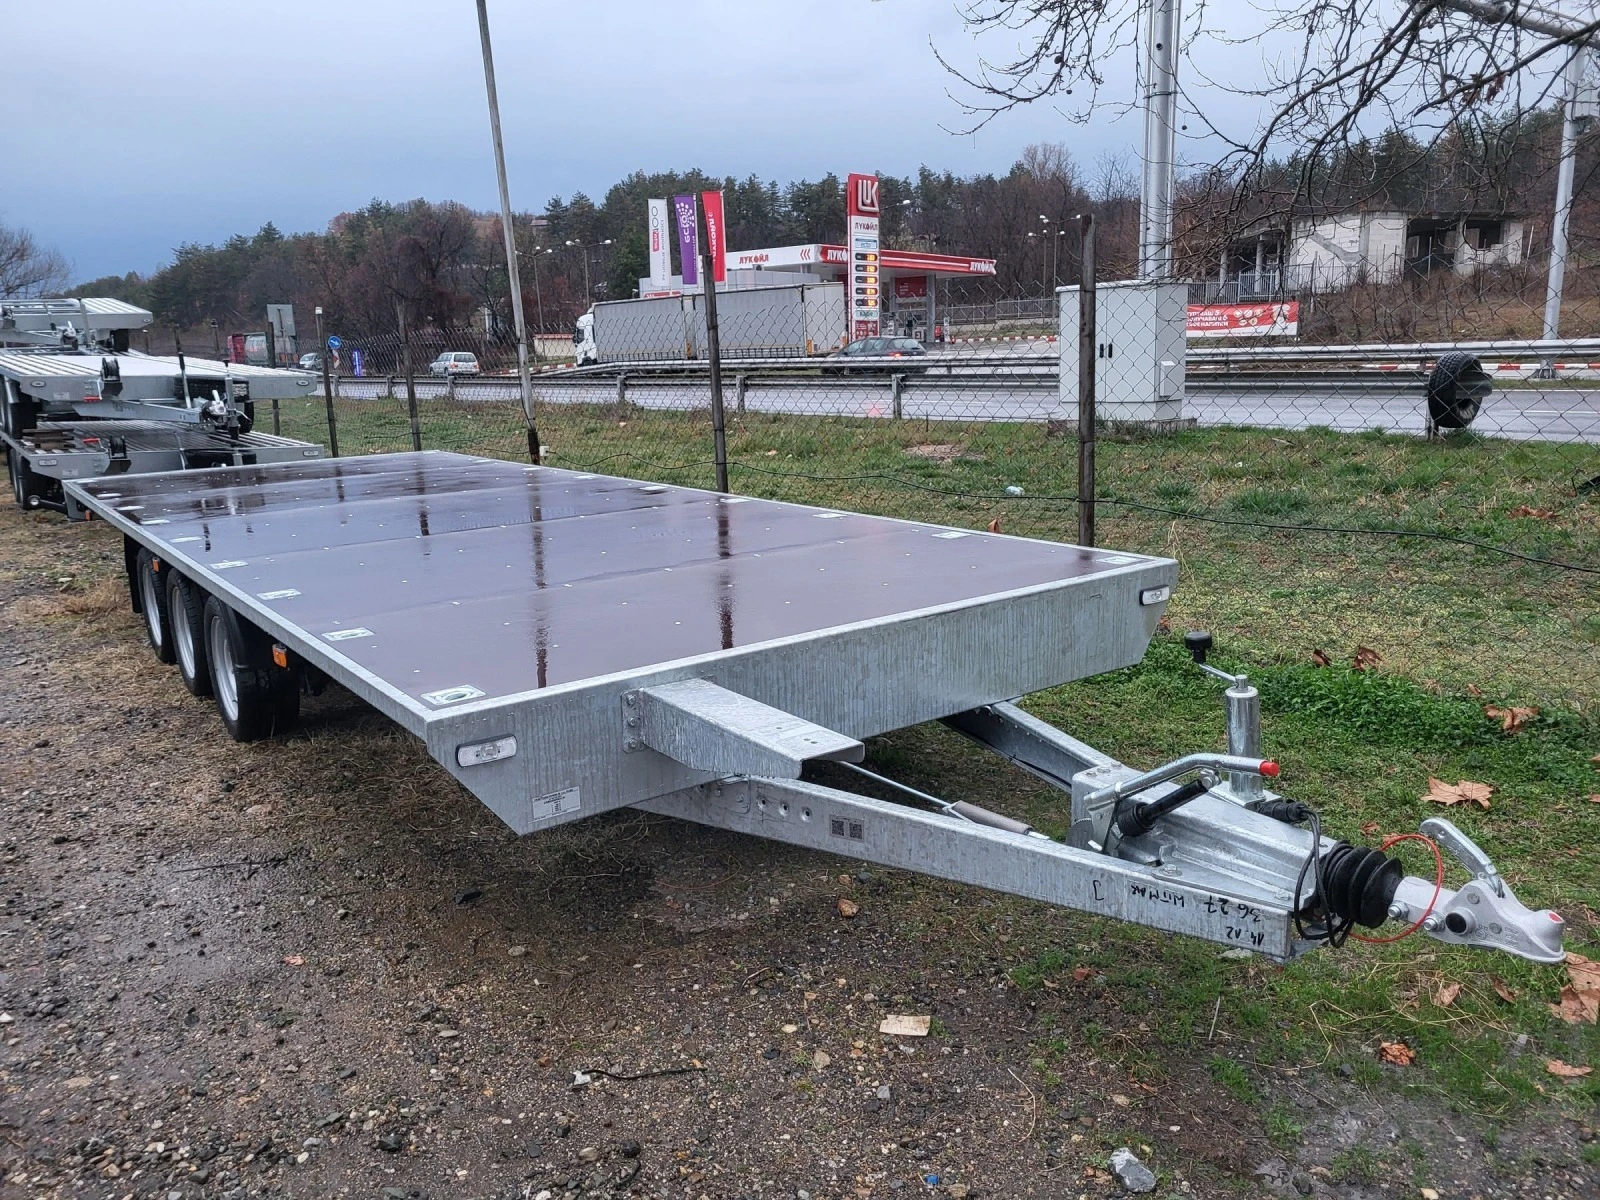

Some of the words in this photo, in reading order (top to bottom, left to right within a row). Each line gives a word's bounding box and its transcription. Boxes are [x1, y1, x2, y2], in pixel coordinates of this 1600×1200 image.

[855, 221, 878, 231] ЛУКОЙЛ
[739, 253, 770, 265] ЛУКОЙЛ
[826, 248, 849, 262] ЛУКО
